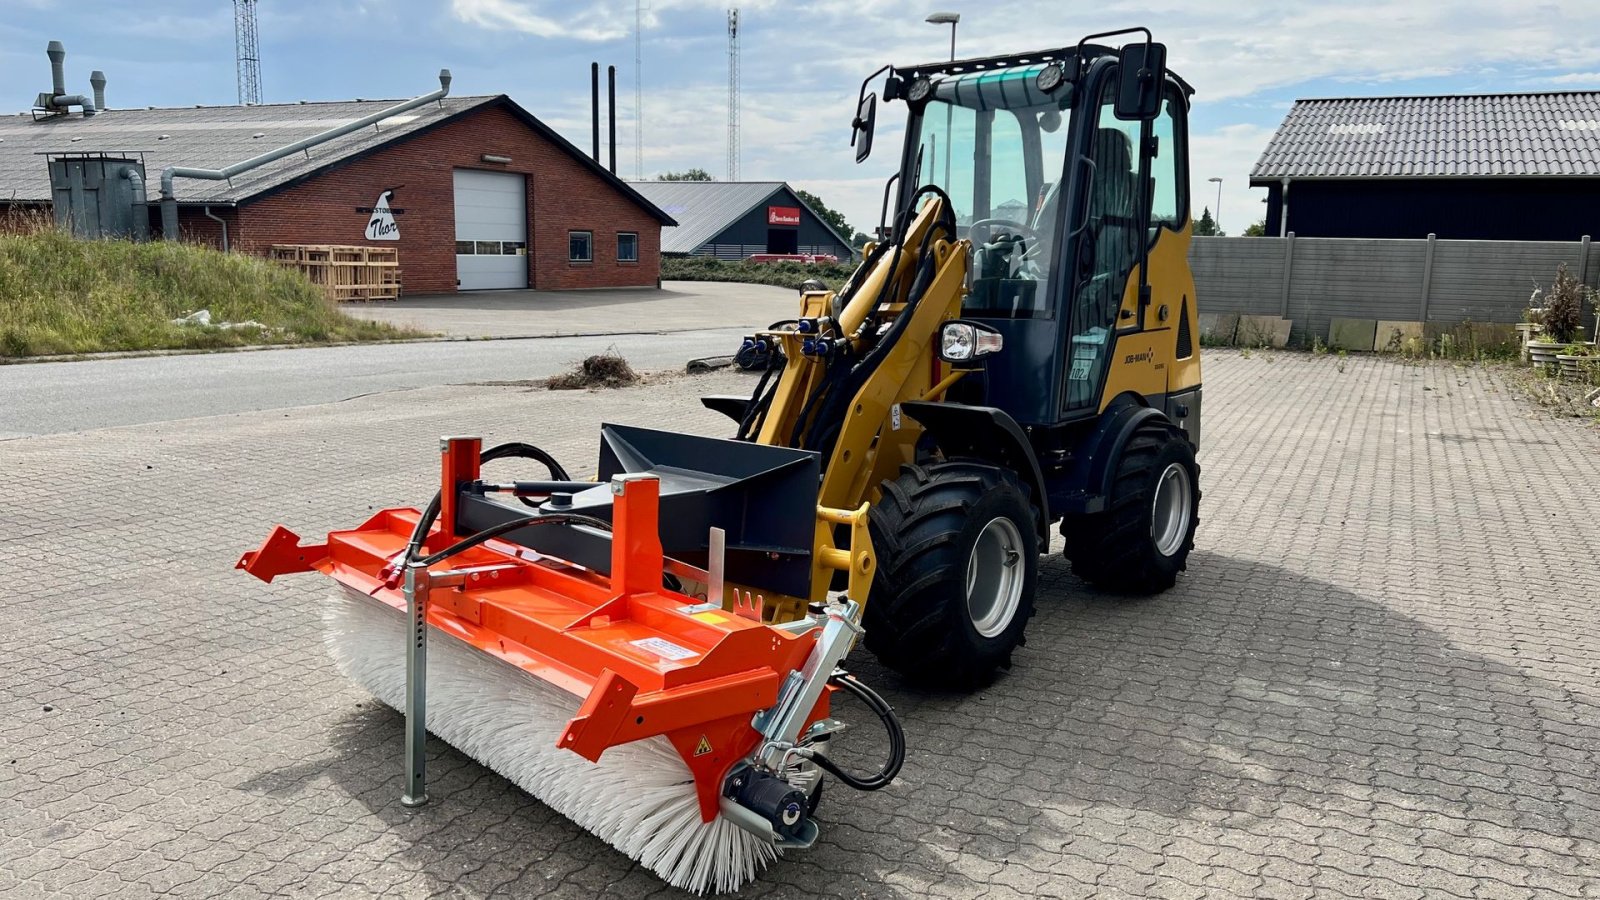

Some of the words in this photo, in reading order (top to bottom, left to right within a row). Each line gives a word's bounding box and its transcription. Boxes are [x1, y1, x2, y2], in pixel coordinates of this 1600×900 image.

[370, 217, 397, 238] Thor
[1124, 352, 1147, 364] JOB-MAN
[1071, 368, 1085, 379] 102
